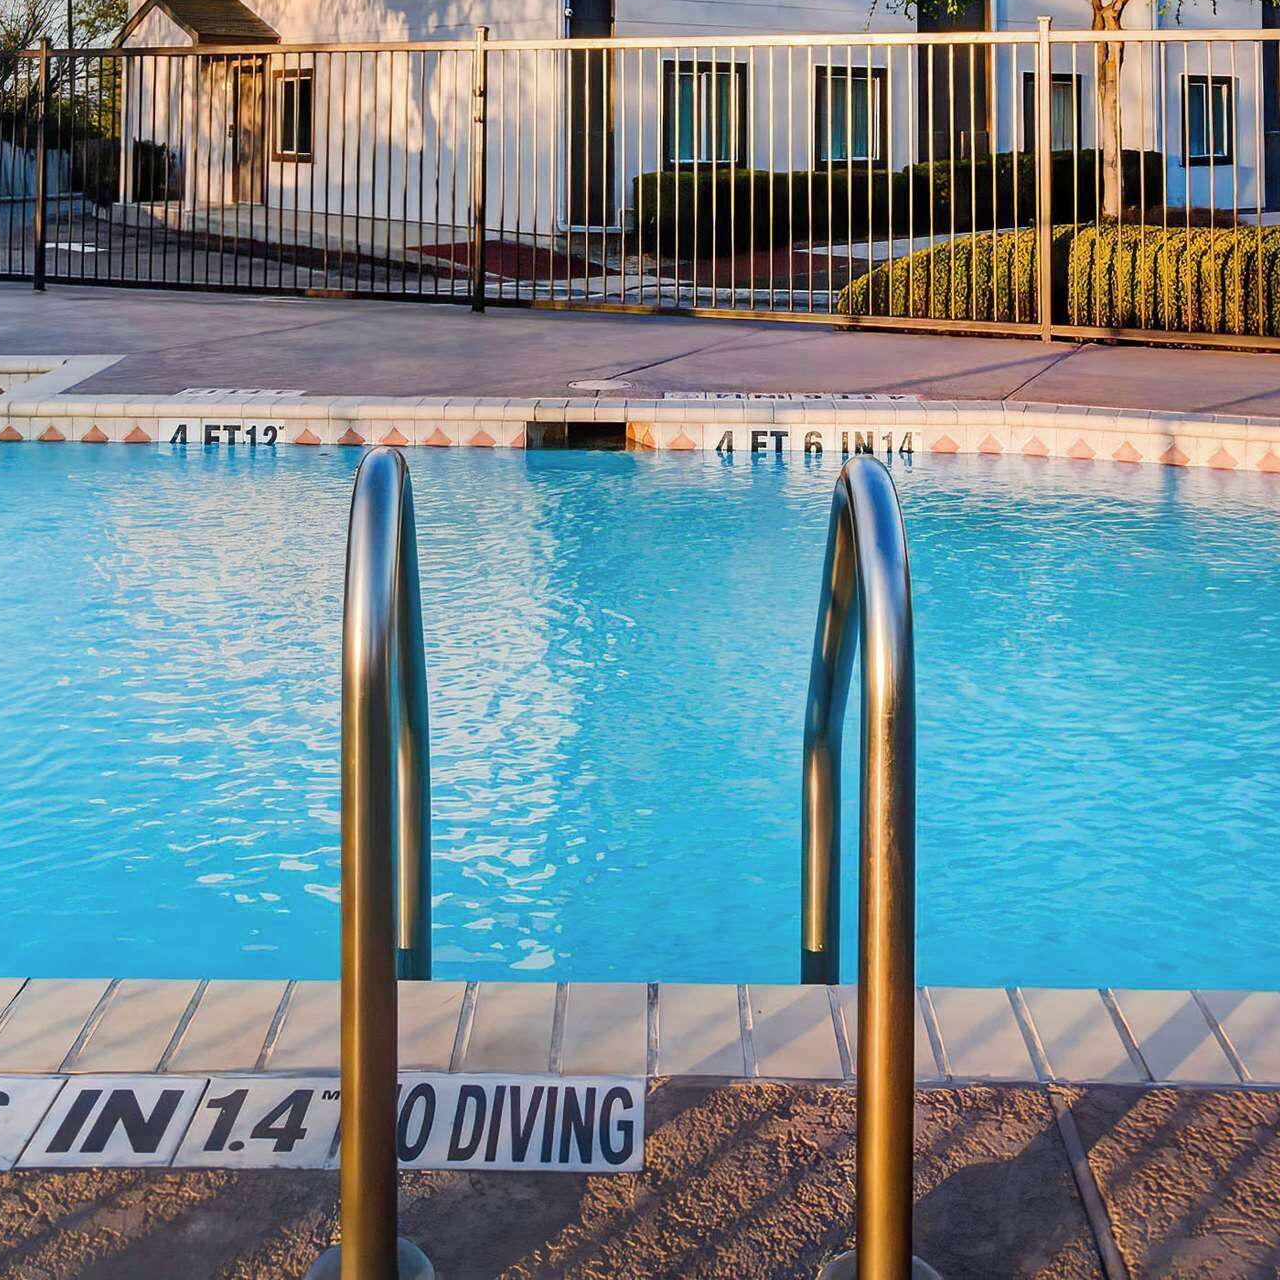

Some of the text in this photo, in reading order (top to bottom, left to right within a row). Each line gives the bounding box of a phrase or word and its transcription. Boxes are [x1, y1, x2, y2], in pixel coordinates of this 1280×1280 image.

[170, 424, 188, 445] 4
[204, 425, 242, 446] FT
[715, 430, 735, 453] 4
[751, 430, 789, 454] FT
[804, 430, 824, 453] 6
[841, 430, 874, 455] IN
[45, 1088, 186, 1154] IN
[446, 1083, 635, 1166] DIVING
